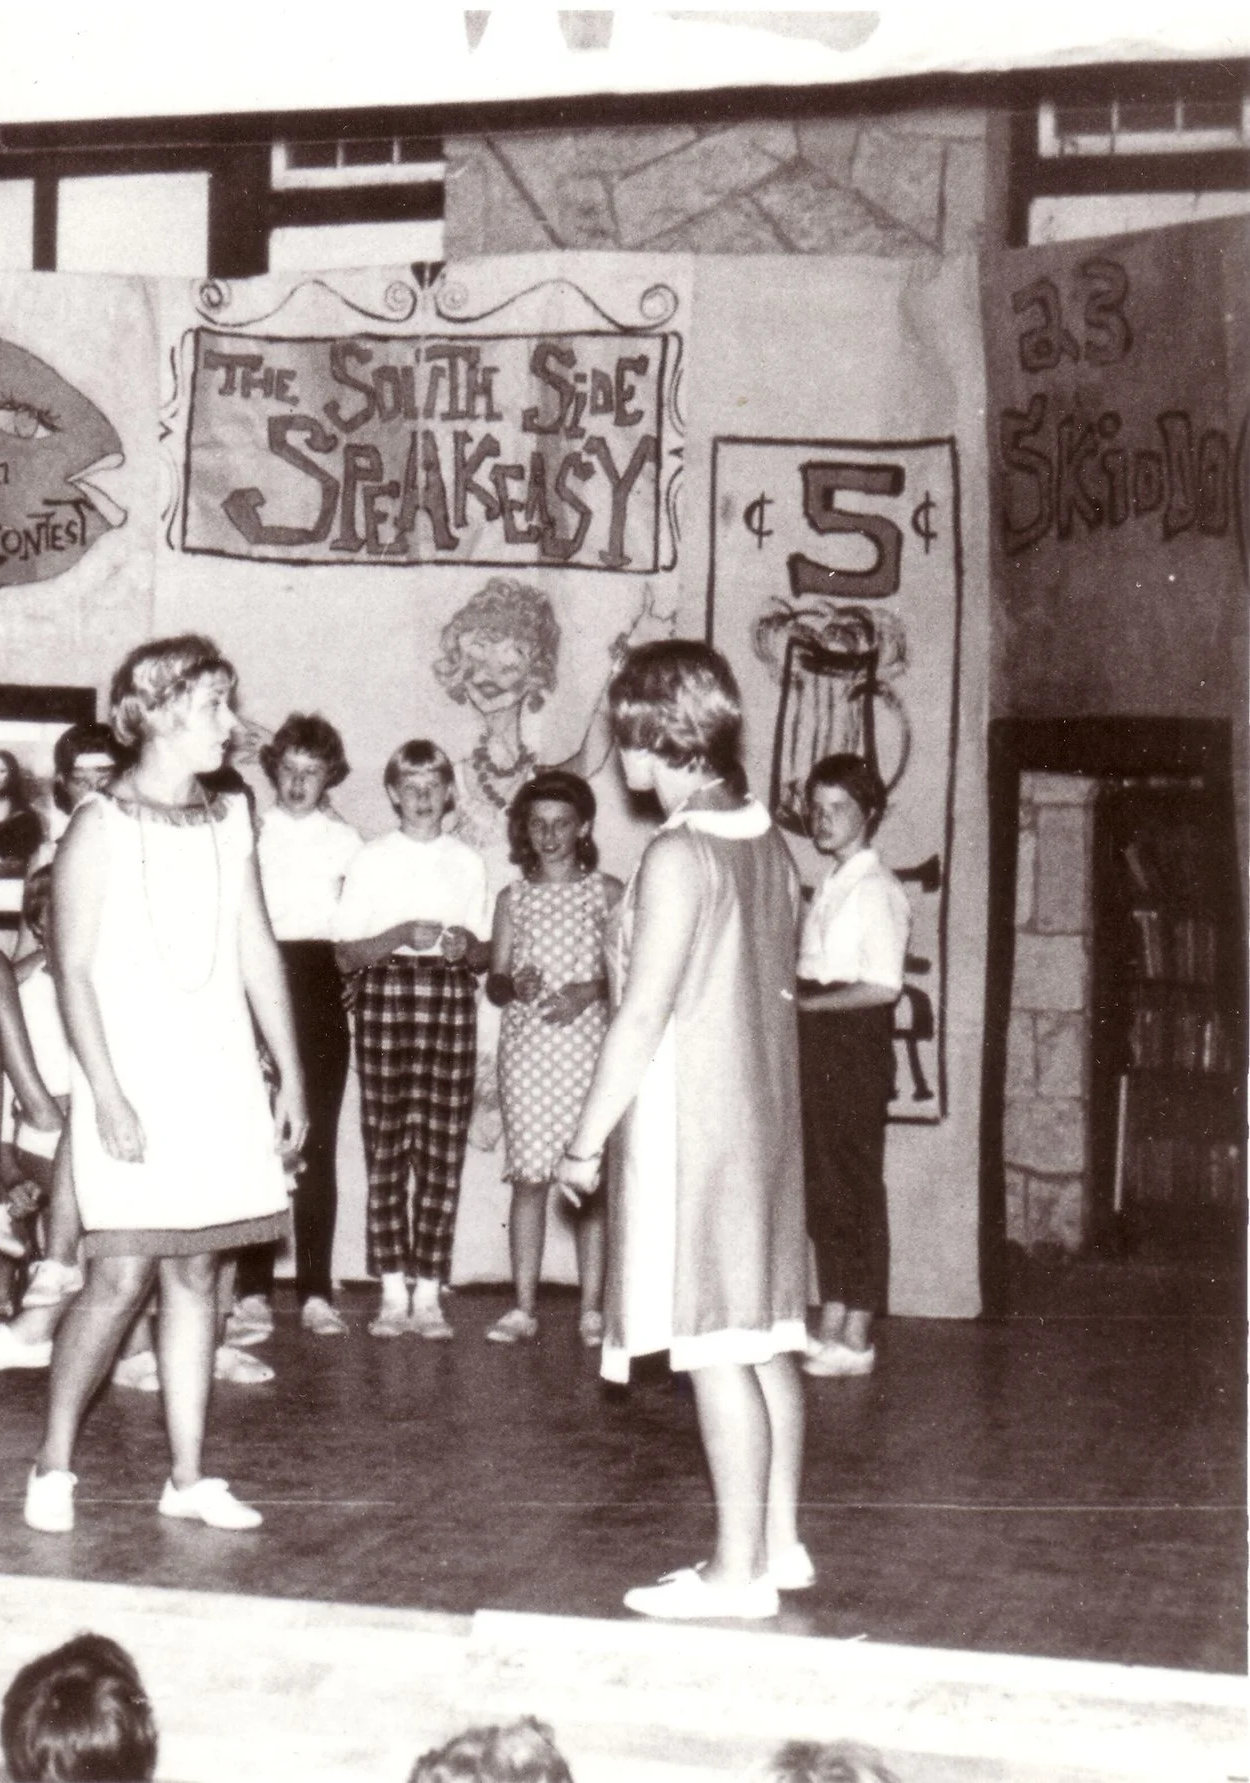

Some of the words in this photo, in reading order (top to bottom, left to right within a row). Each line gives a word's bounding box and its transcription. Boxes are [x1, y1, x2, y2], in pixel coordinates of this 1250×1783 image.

[1011, 256, 1133, 374] 23
[203, 349, 299, 406] THE
[323, 337, 502, 433] SOUTH
[221, 415, 657, 567] SPEAKEASY
[788, 461, 905, 600] 5
